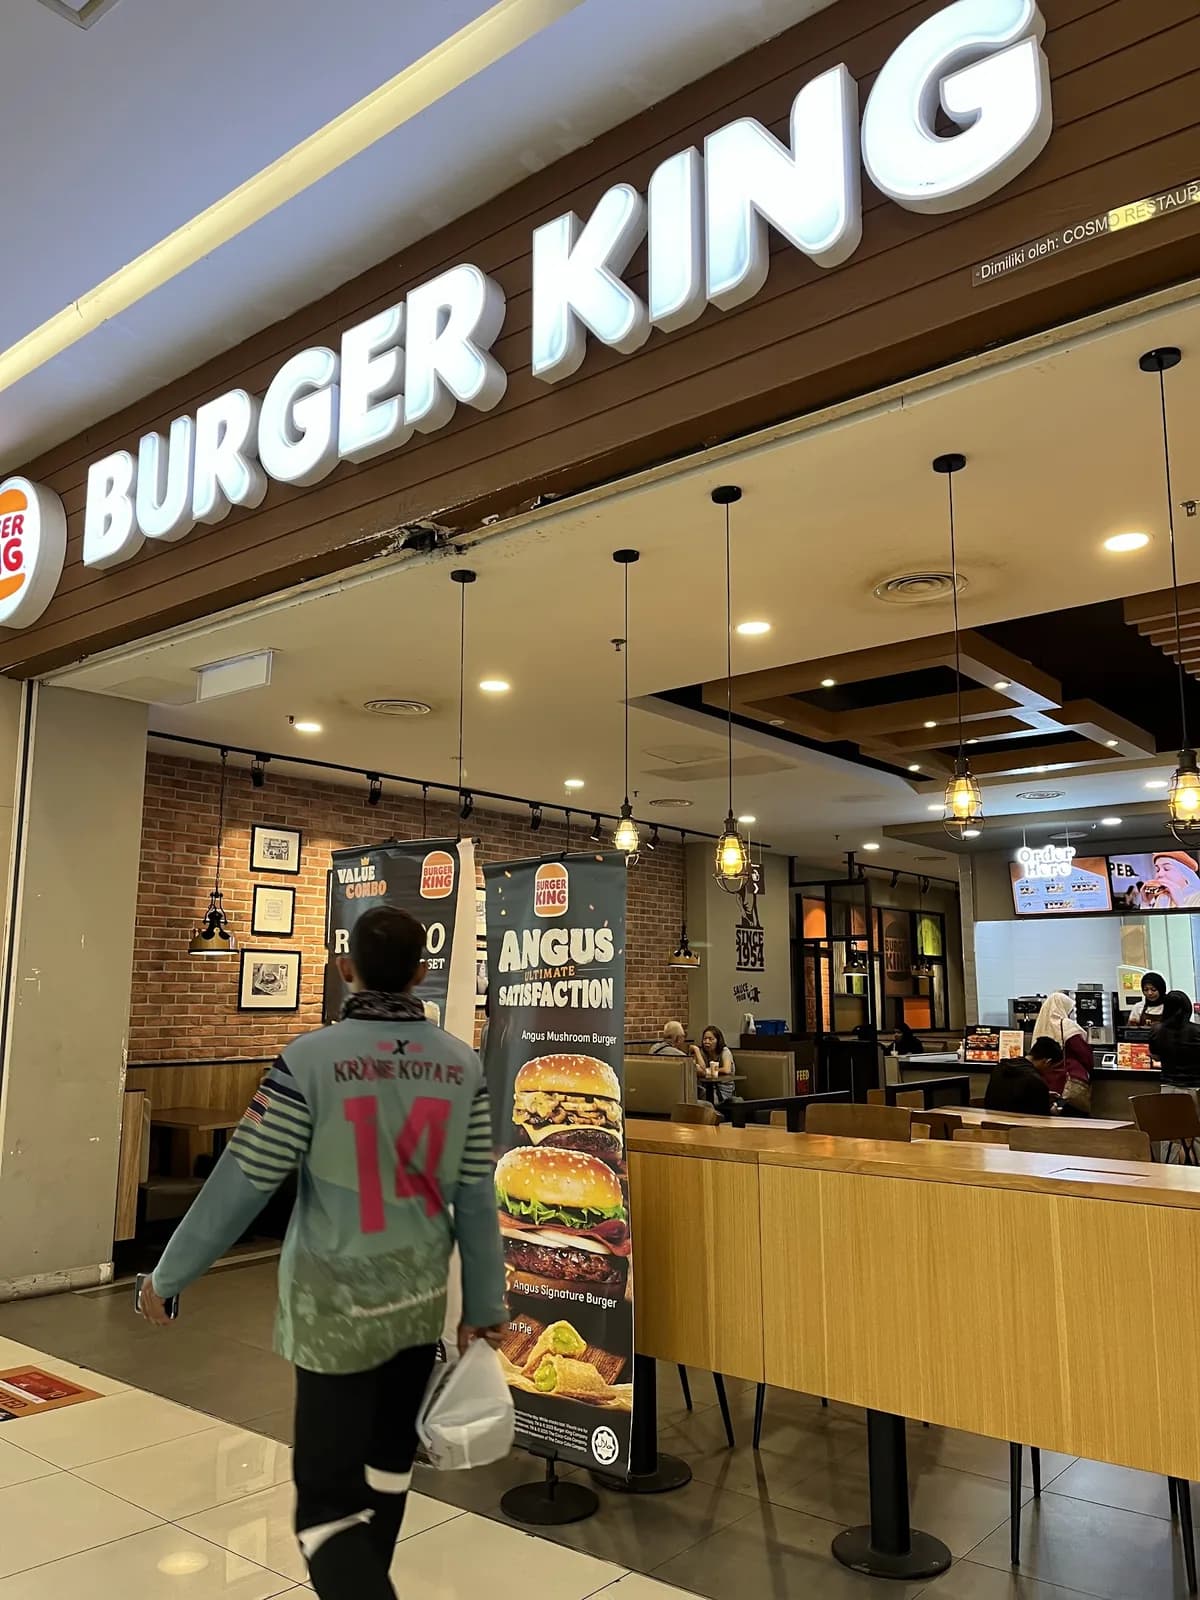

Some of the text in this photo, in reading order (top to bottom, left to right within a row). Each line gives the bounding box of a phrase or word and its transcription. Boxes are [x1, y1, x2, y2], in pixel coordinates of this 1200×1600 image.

[980, 183, 1200, 279] Dimiliki oleh: COSMO RESTAUR
[83, 0, 1053, 569] BURGER KING
[0, 538, 23, 575] G
[337, 865, 376, 884] VALUE
[423, 864, 453, 876] BURGER
[345, 880, 387, 899] COMBO
[422, 875, 452, 889] KING
[536, 878, 567, 891] BURGER
[535, 890, 567, 906] KING
[736, 929, 764, 946] SINCE
[498, 928, 615, 972] ANGUS
[736, 944, 765, 968] 1954
[524, 965, 576, 982] ULTIMATE
[498, 978, 614, 1010] SATISFACTION
[521, 1029, 617, 1047] Angus Mushroom Burger
[796, 1069, 810, 1081] FEED
[344, 1095, 452, 1235] 14
[513, 1279, 618, 1310] Angus Signature Burger
[519, 1321, 532, 1335] Pie
